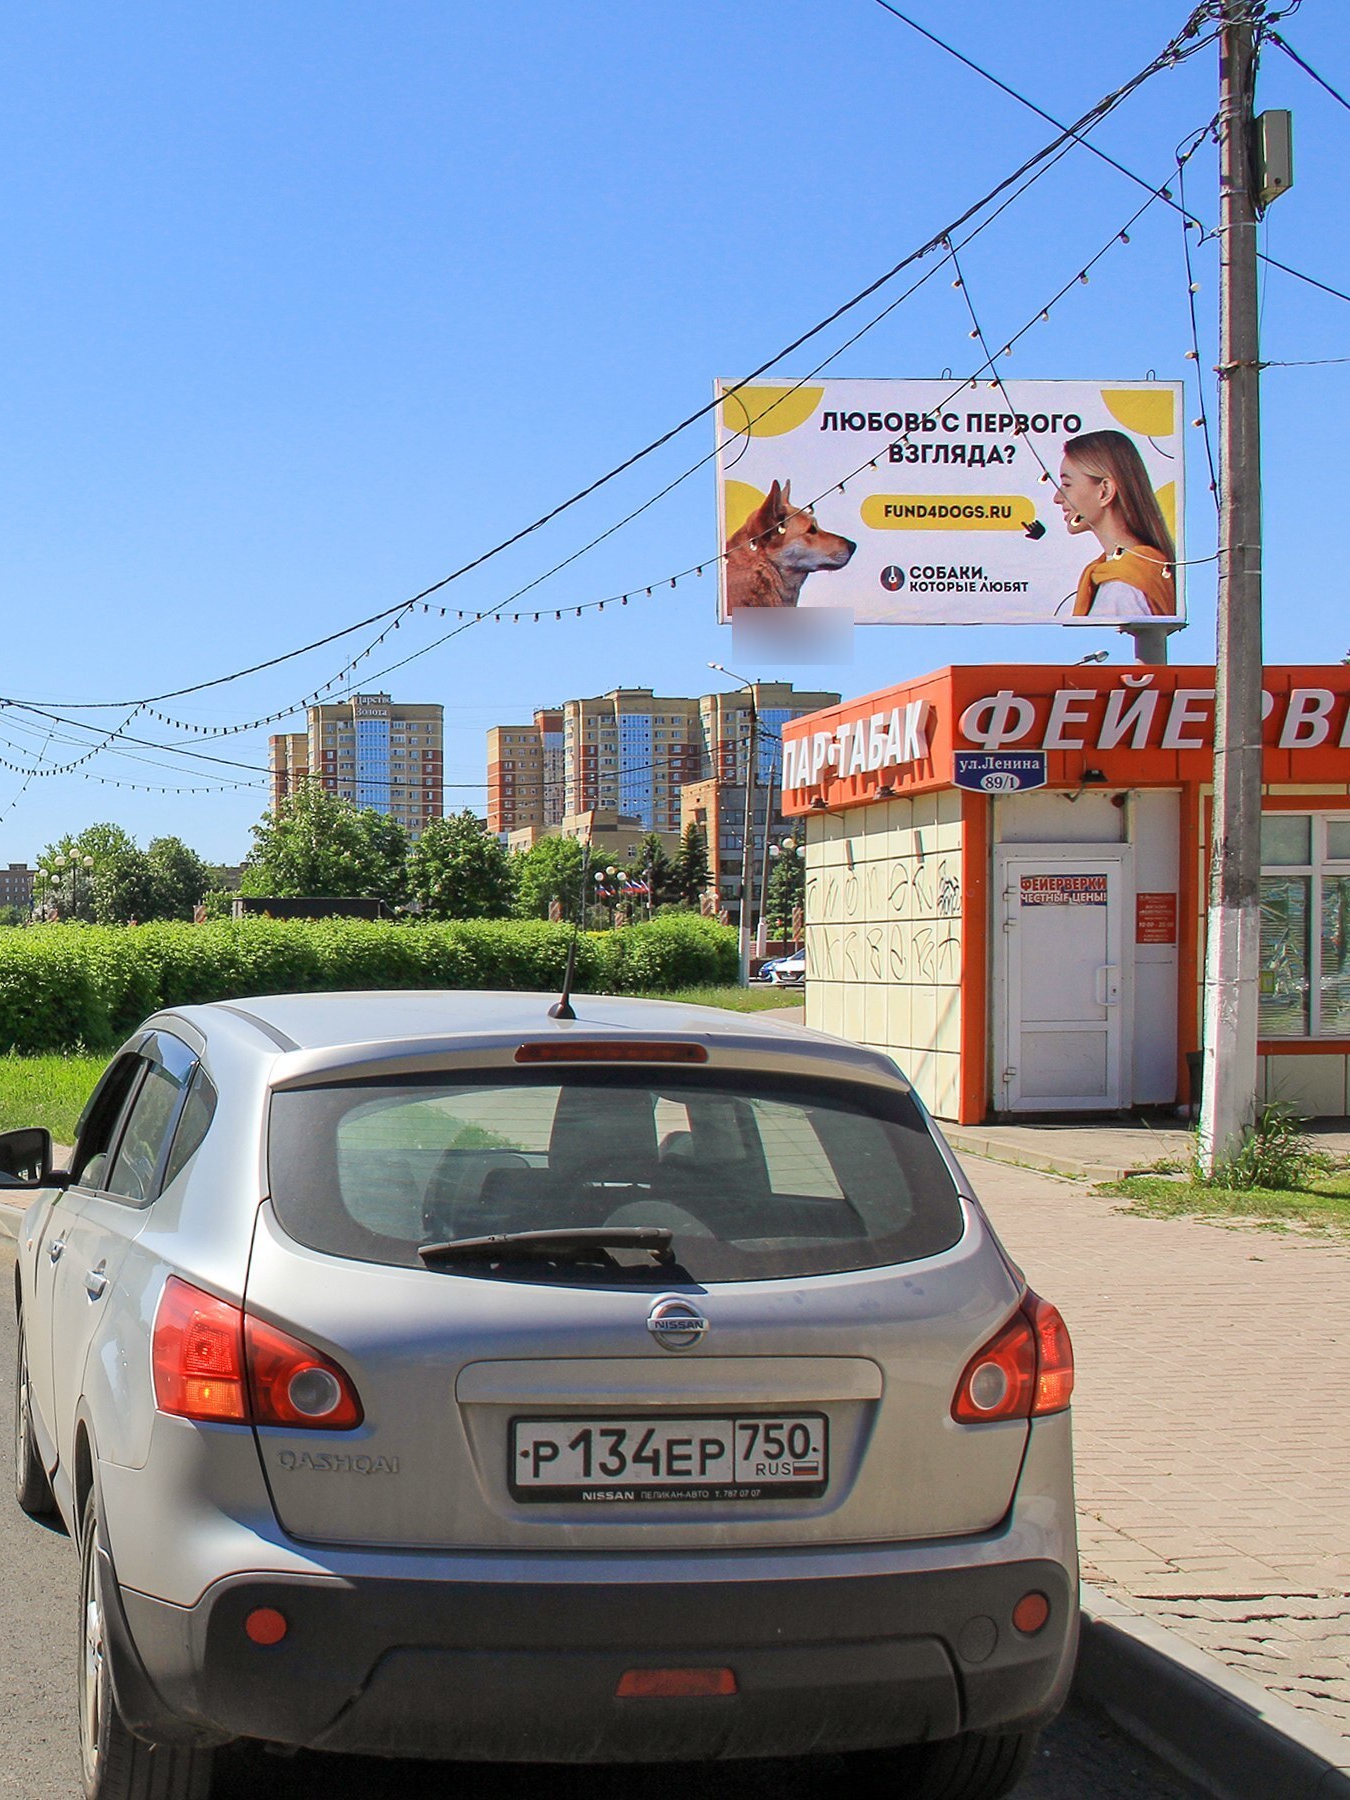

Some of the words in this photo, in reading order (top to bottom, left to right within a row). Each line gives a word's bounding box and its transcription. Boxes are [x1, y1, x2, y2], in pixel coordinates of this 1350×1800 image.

[820, 412, 937, 432] ЛЮБОВЬ
[941, 412, 959, 432] С
[966, 413, 1082, 433] ПЕРВОГО
[888, 444, 1016, 467] ВЗГЛЯДА?
[884, 505, 1012, 518] FUND4DOGS.RU
[910, 566, 988, 581] СОБАКИ,
[910, 581, 976, 593] КОТОРЫЕ
[980, 581, 1028, 593] ЛЮБЯТ
[958, 673, 1350, 750] ФЕЙЕВ
[985, 775, 1015, 789] 89/1
[1021, 893, 1069, 904] ЧЕСТНЫЕ
[1072, 892, 1107, 904] ЦЕНЫ!
[654, 1320, 704, 1329] NISSAN
[738, 1422, 811, 1461] 750
[278, 1449, 399, 1474] QASHQAI
[755, 1461, 791, 1477] RUS
[582, 1490, 635, 1501] NISSAN
[640, 1489, 710, 1499] ПЕЛИКАН-АВТО
